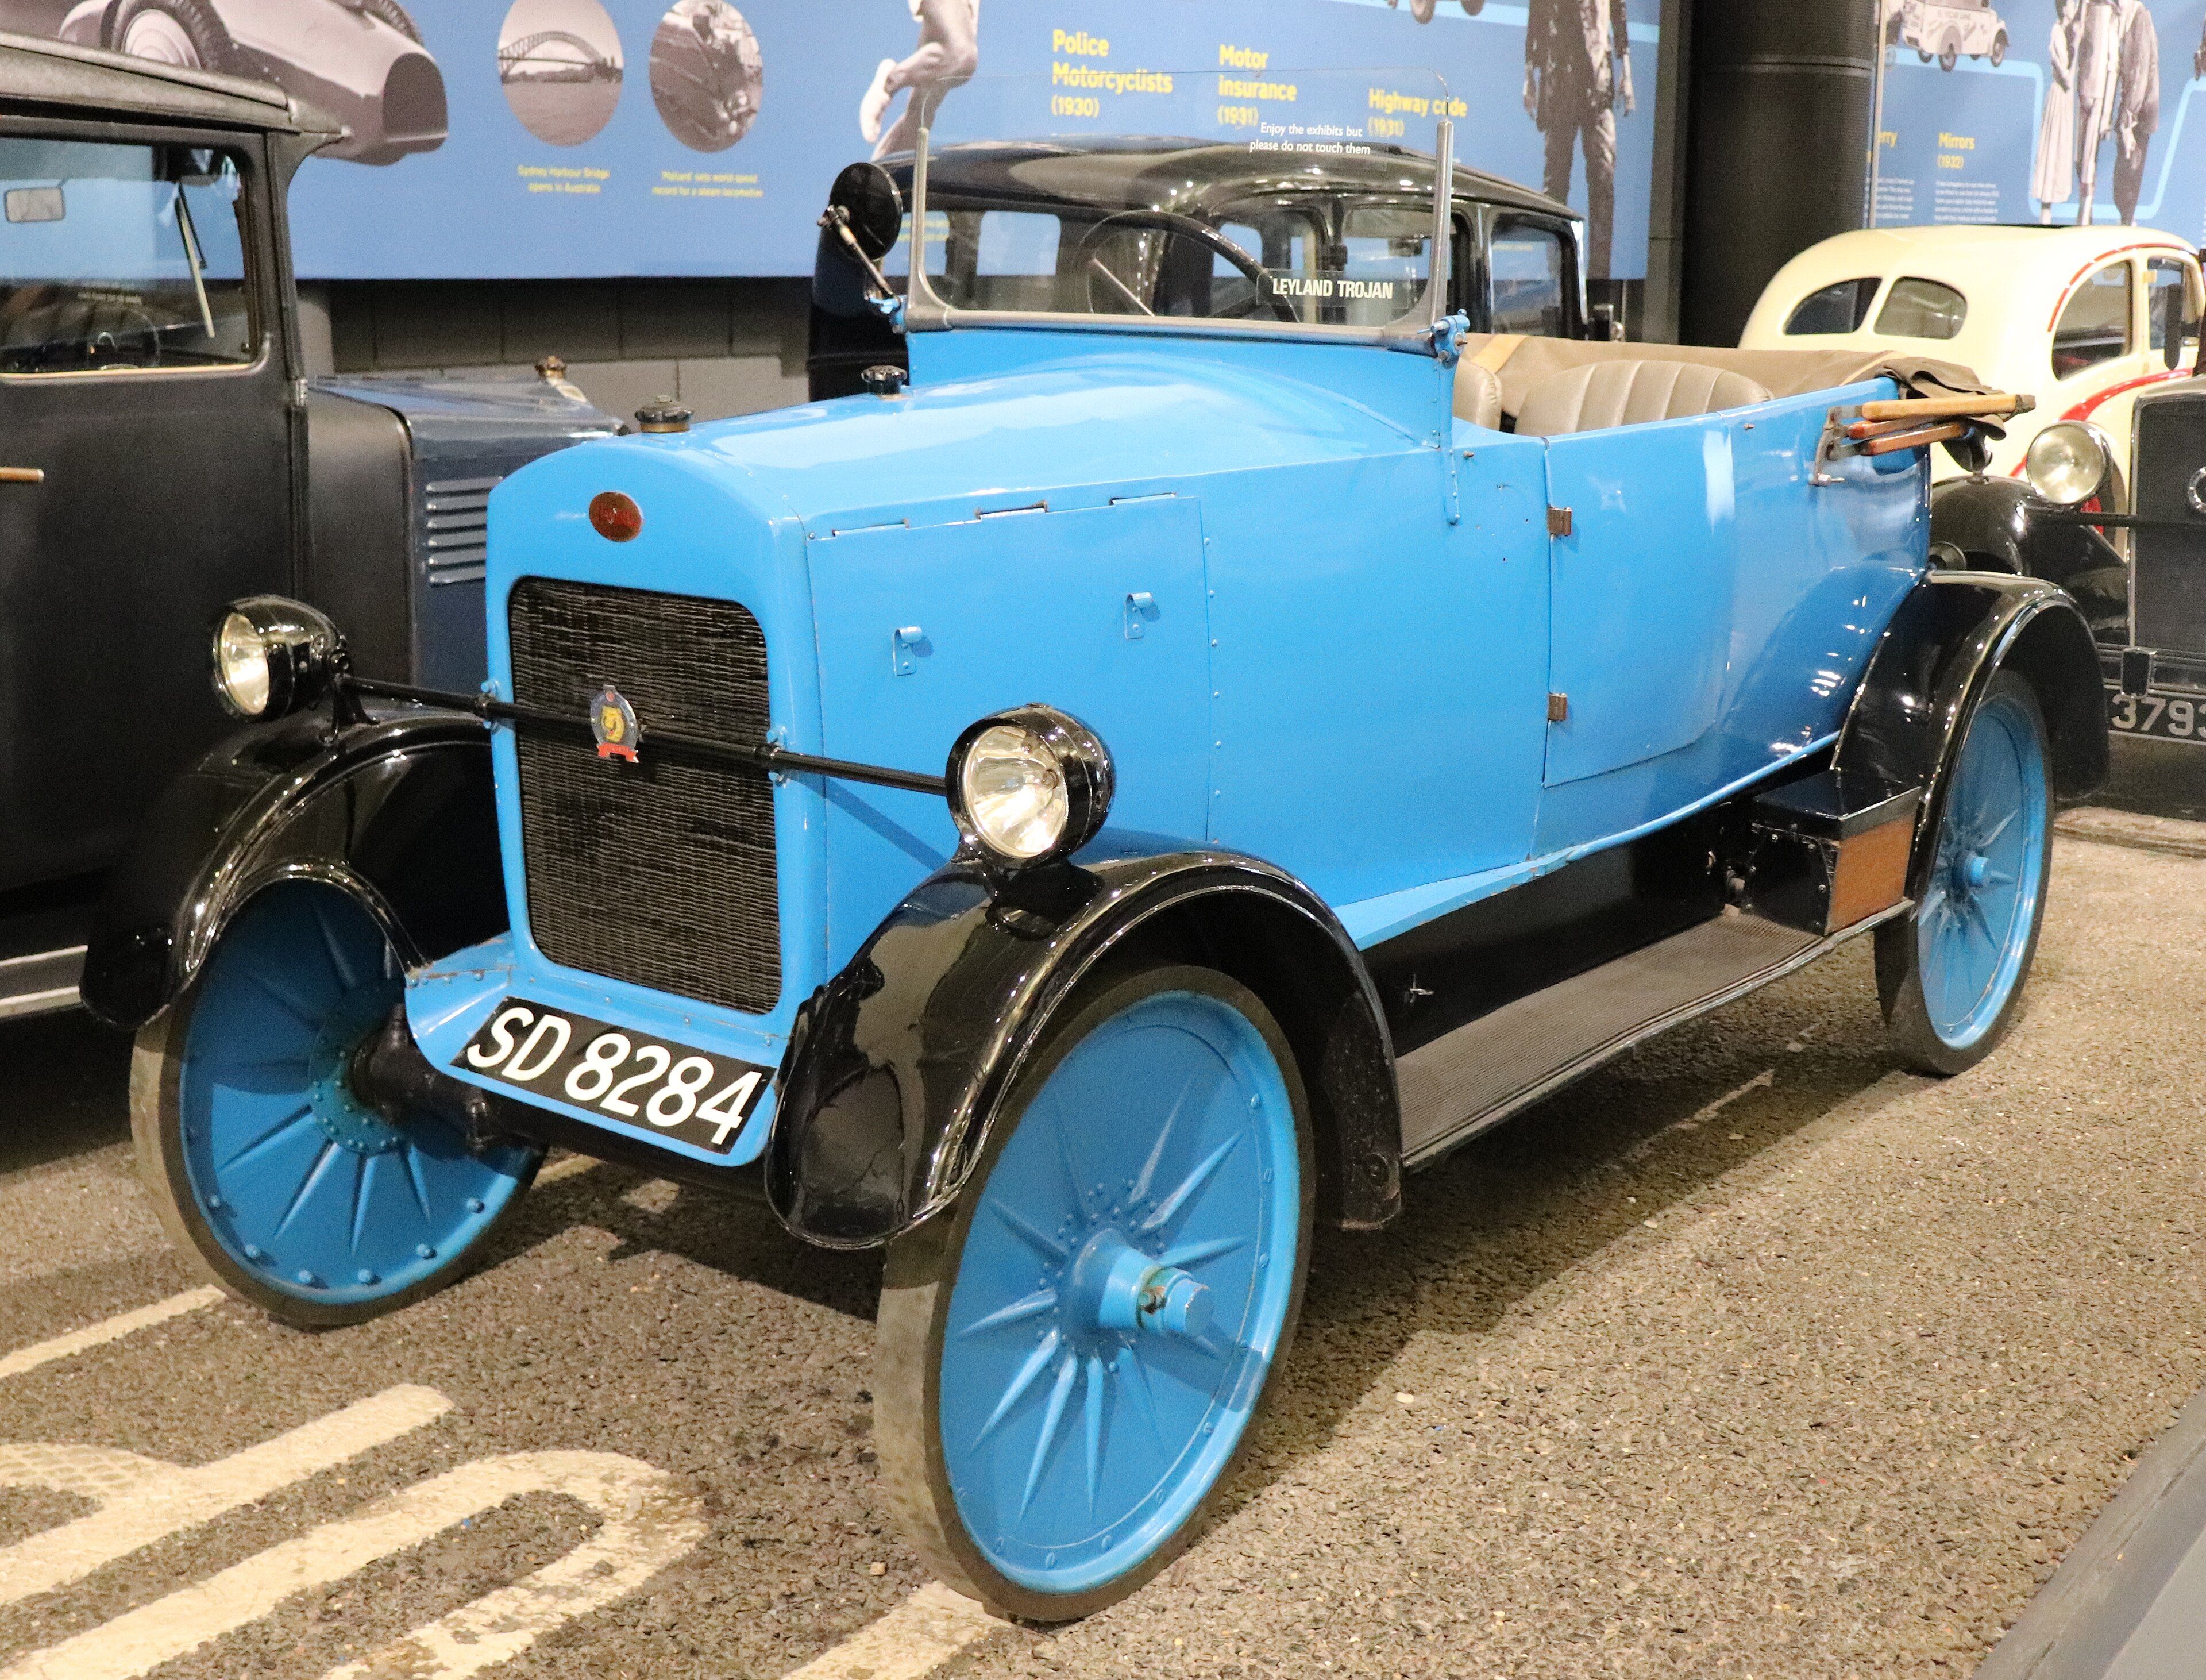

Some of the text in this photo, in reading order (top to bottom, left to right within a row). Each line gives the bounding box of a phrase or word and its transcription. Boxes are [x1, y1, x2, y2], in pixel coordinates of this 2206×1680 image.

[1052, 29, 1109, 56] Police
[1219, 44, 1269, 68] Motor
[1052, 61, 1173, 95] Motorcyclists
[1218, 74, 1297, 101] insurance
[1051, 94, 1100, 118] (1930)
[1369, 88, 1468, 117] Highway code
[1260, 122, 1363, 137] Enjoy the exhibits but
[1939, 132, 1975, 150] Mirrors
[1249, 139, 1371, 155] please do not touch them
[1272, 278, 1393, 299] LEYLAND TROJAN
[466, 1007, 762, 1145] SD 8284
